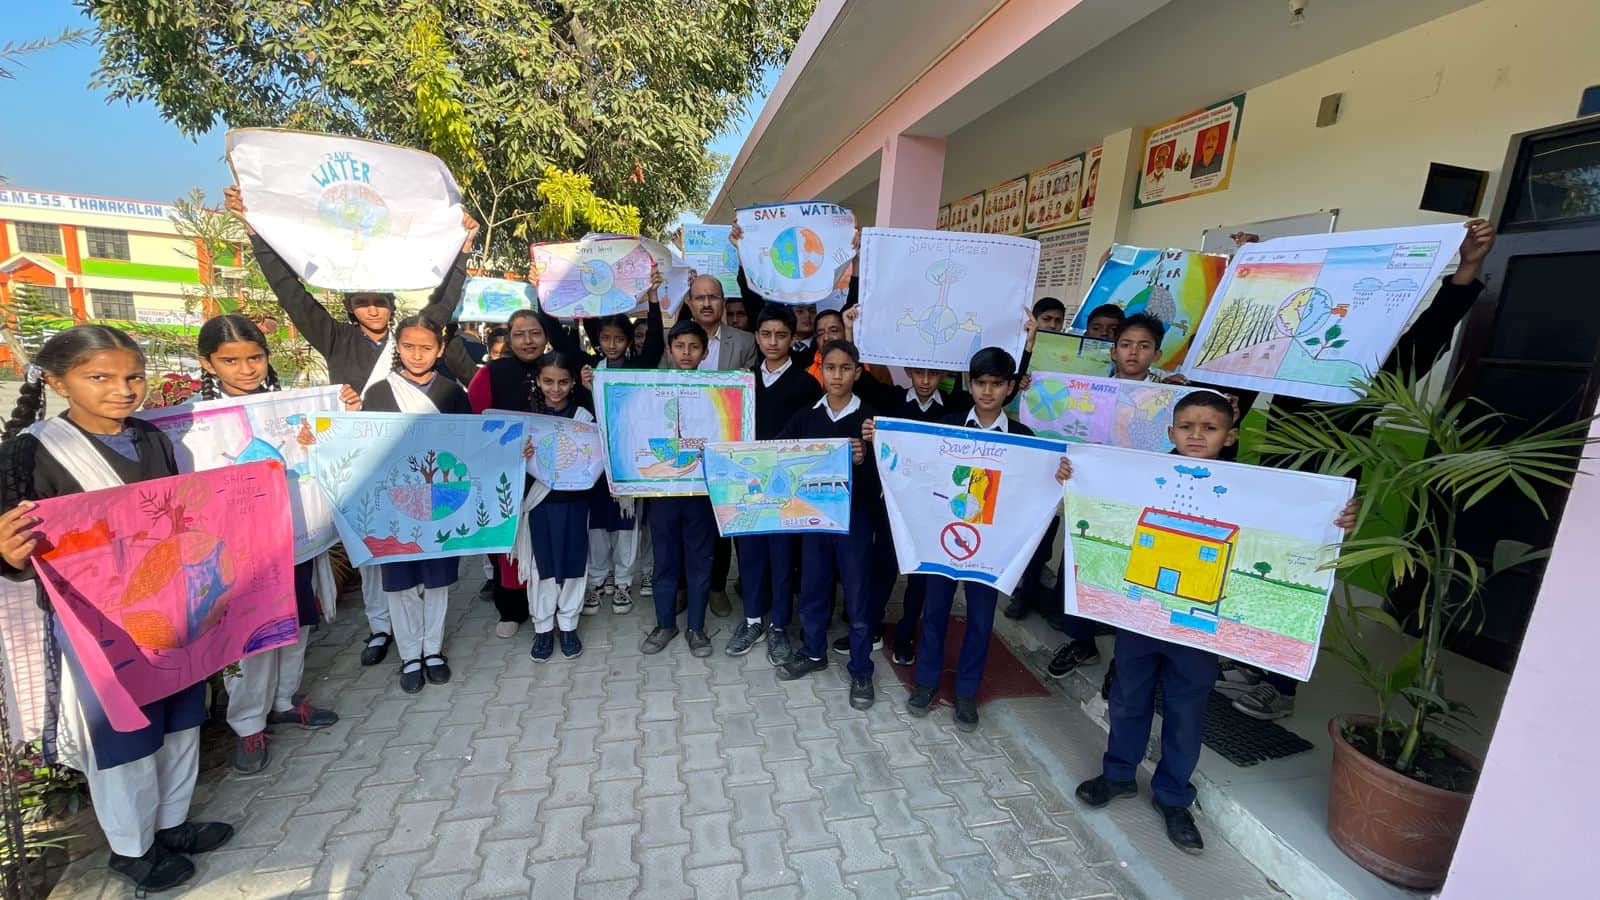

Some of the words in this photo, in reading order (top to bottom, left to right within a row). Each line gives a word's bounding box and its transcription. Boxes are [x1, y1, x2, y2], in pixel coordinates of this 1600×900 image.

[311, 158, 370, 187] WATER
[70, 197, 163, 217] THANAKALAN
[754, 208, 787, 221] SAVE
[801, 204, 848, 216] WATER
[940, 439, 971, 455] Save
[972, 442, 1008, 457] Water
